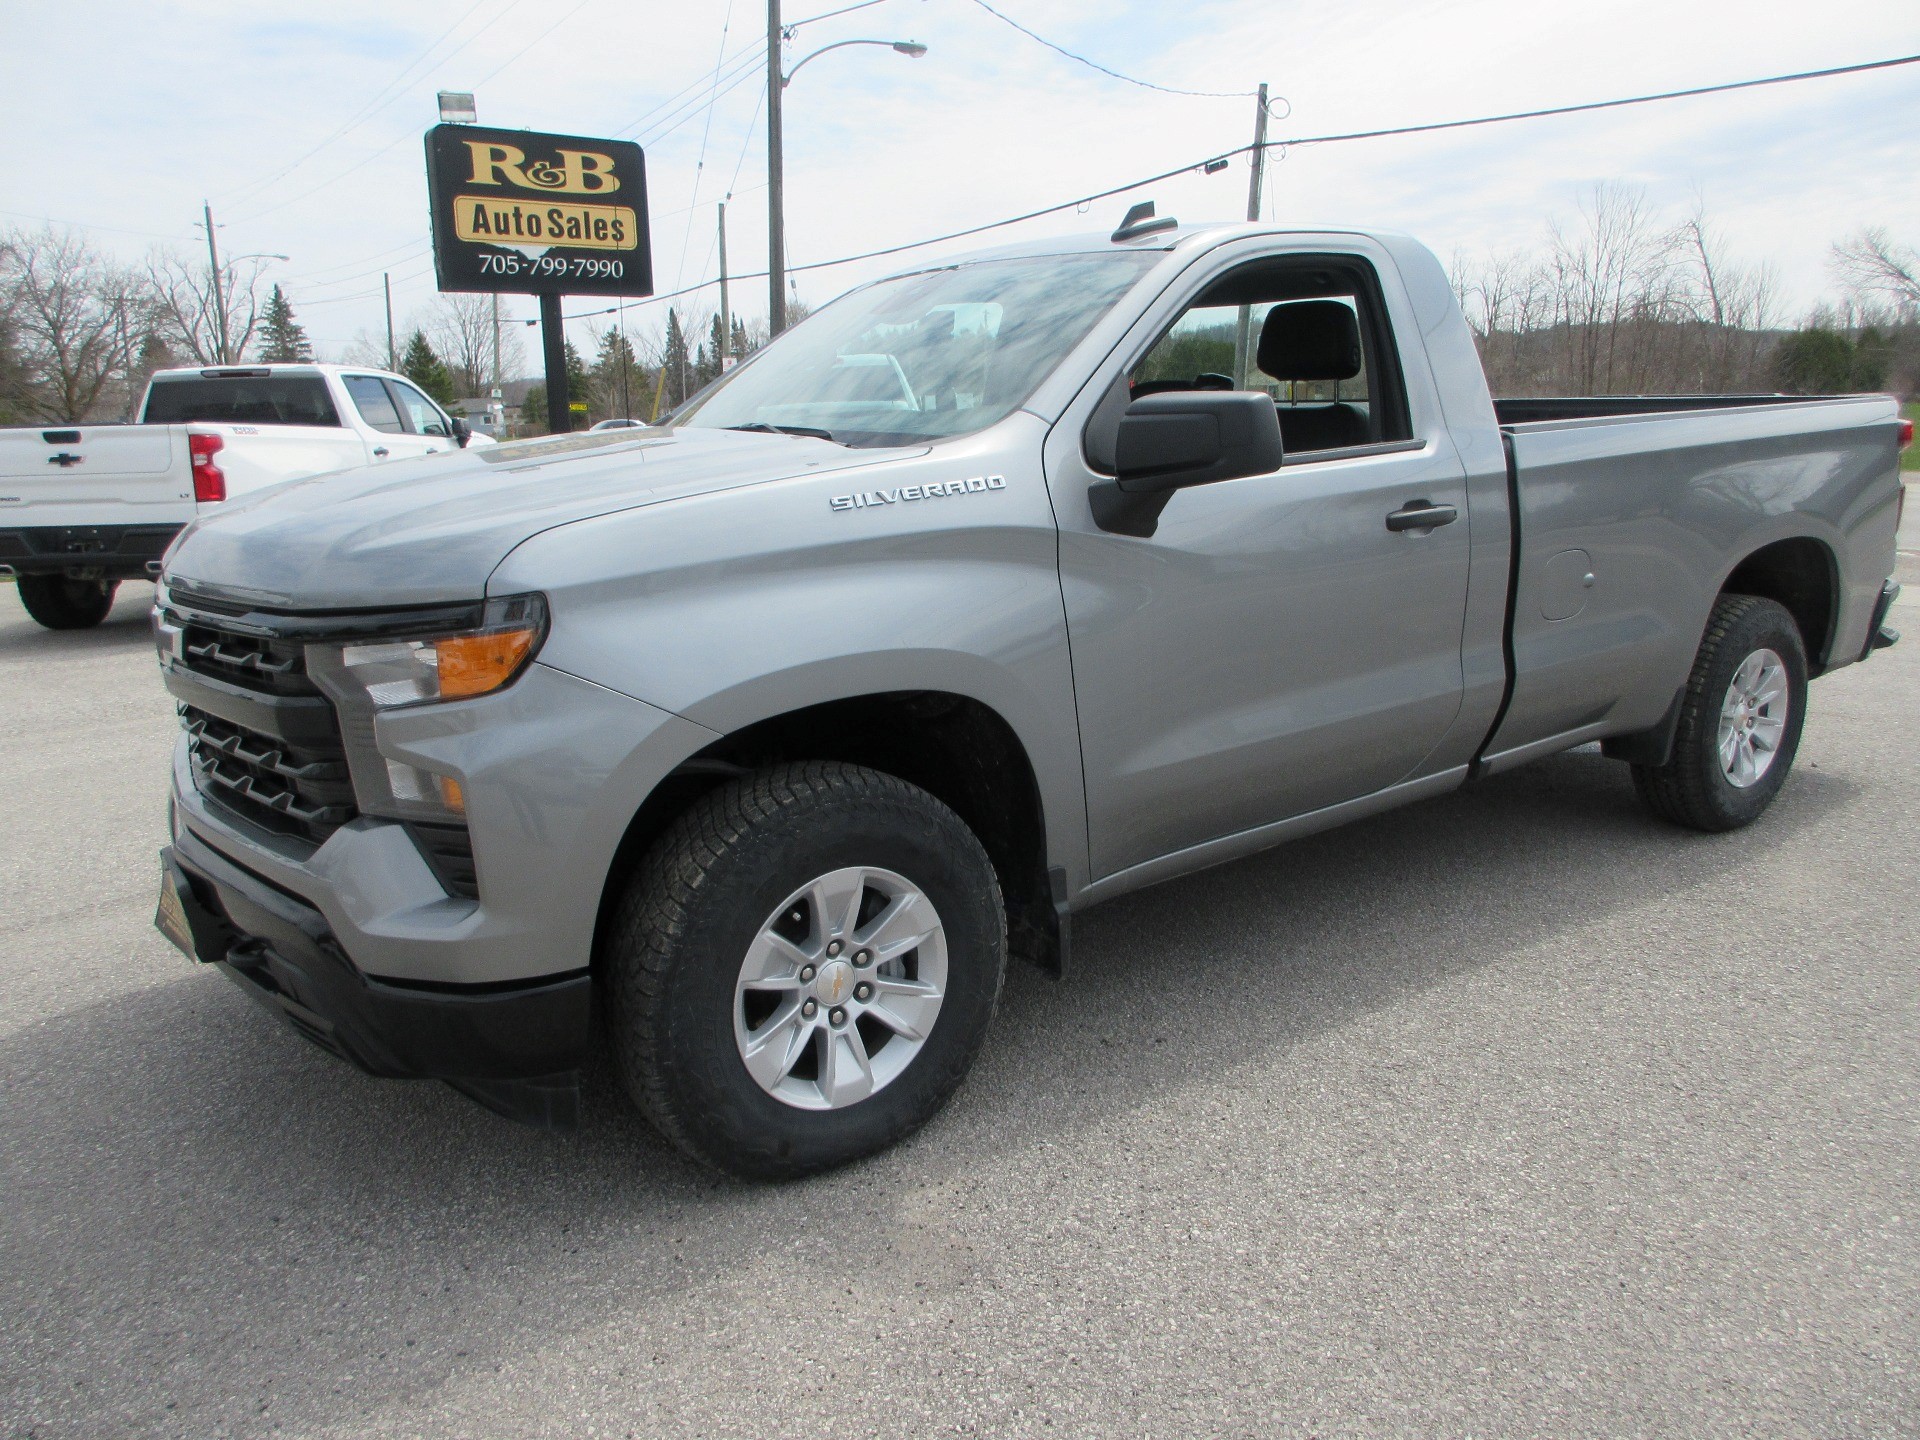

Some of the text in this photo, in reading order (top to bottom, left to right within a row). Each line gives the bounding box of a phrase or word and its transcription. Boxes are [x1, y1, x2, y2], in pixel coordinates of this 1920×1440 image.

[462, 140, 621, 195] R&B
[478, 254, 624, 279] 705-799-7990
[830, 474, 1007, 511] SILVERADO
